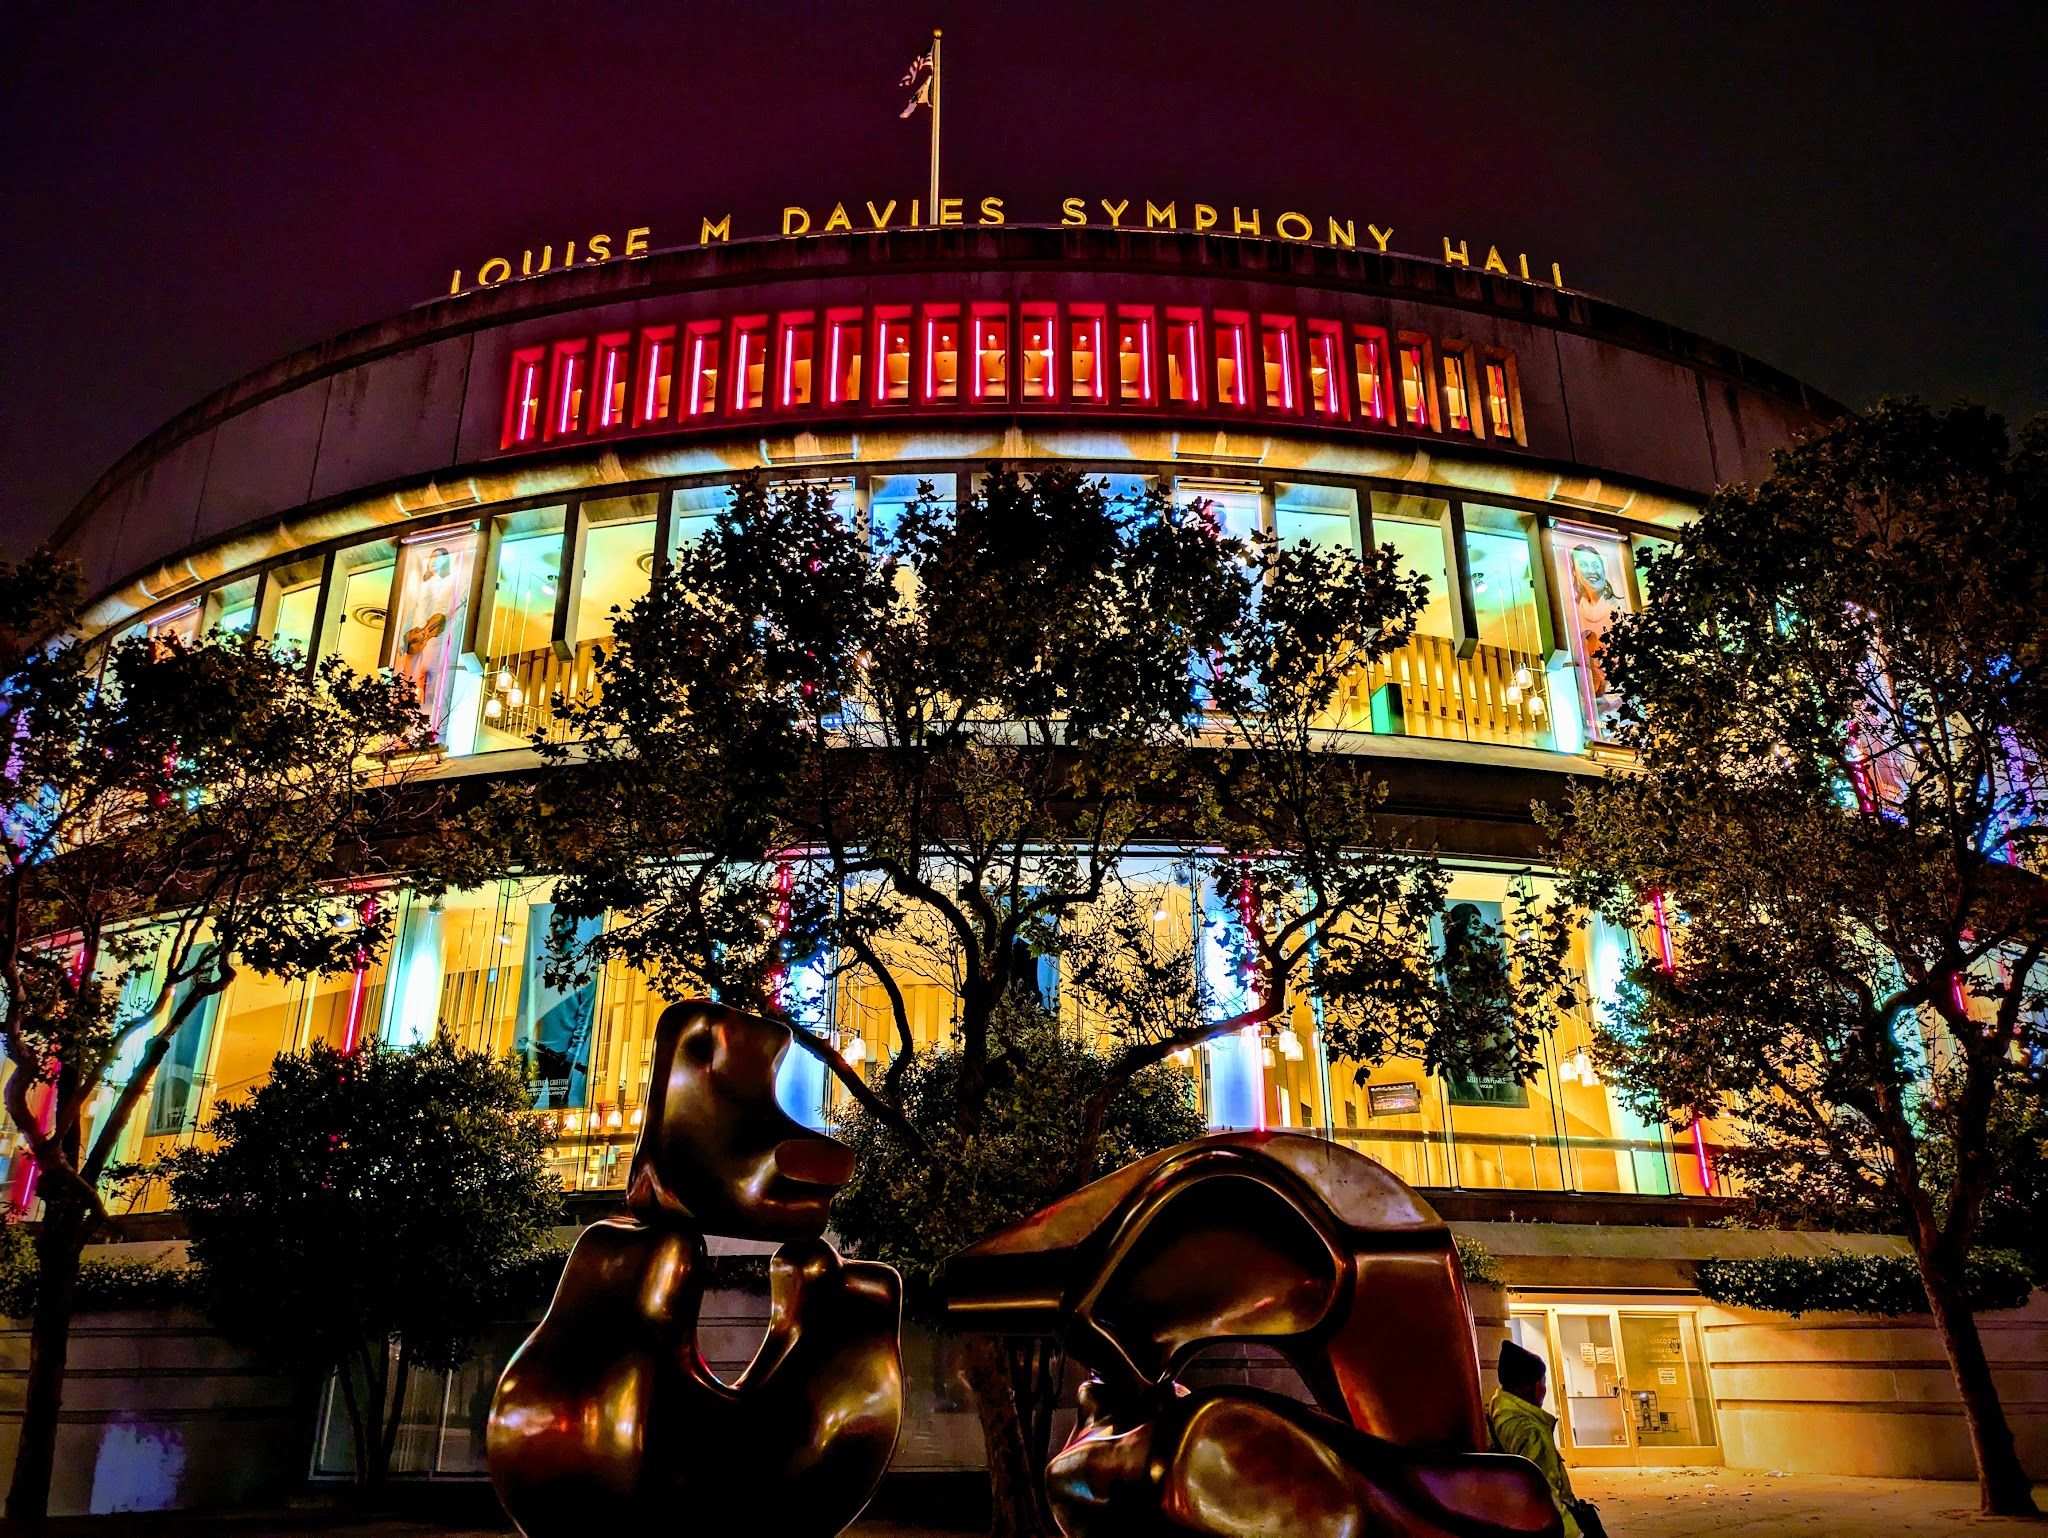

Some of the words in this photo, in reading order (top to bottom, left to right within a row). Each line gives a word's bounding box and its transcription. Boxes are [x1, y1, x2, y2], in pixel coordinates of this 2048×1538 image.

[699, 216, 731, 246] M
[782, 196, 1005, 236] DAVIES
[1061, 197, 1393, 254] SYMPHONY
